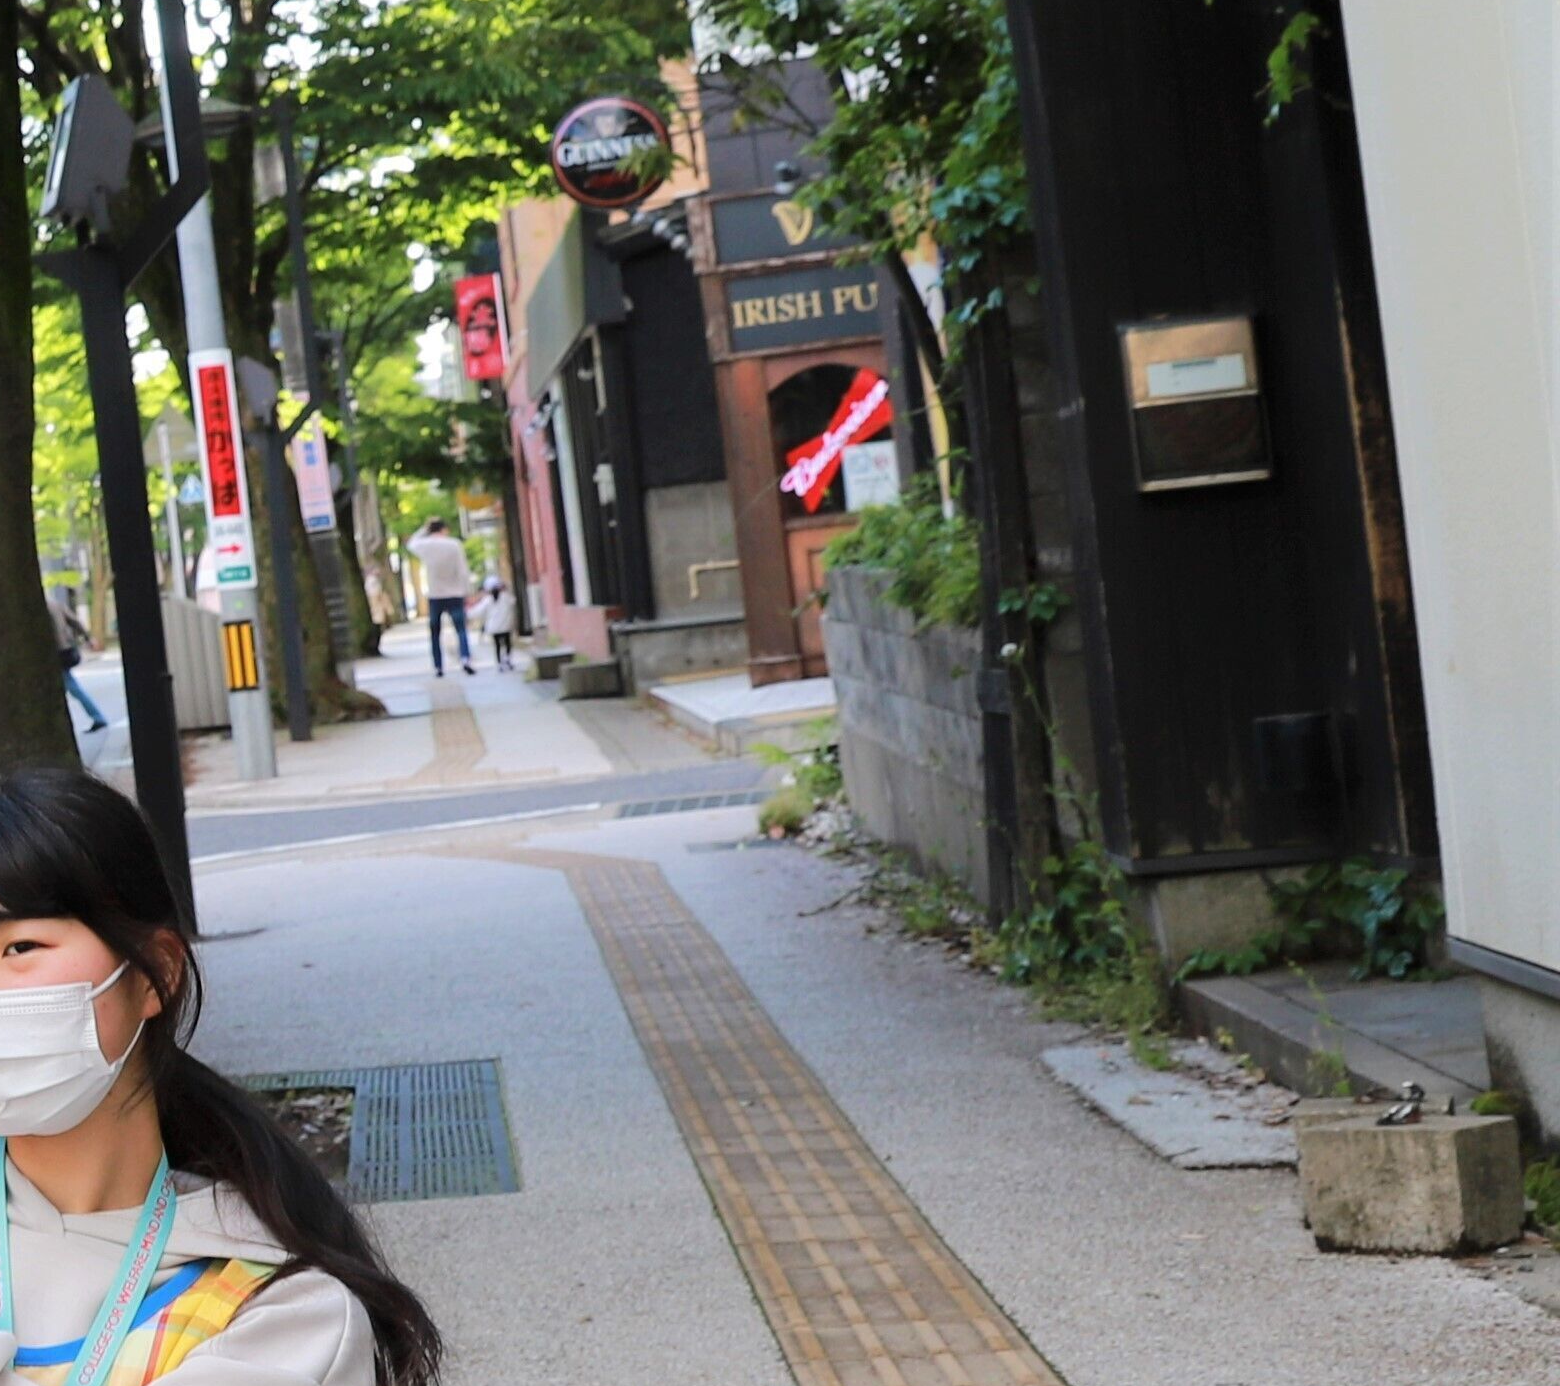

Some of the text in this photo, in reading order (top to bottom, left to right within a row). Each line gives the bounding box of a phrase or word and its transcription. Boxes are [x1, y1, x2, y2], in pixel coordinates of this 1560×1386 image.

[732, 289, 823, 329] IRISH
[79, 1332, 111, 1386] COLLEGE
[106, 1308, 123, 1335] FOR
[116, 1253, 150, 1305] WELFARE
[140, 1217, 160, 1252] MIND
